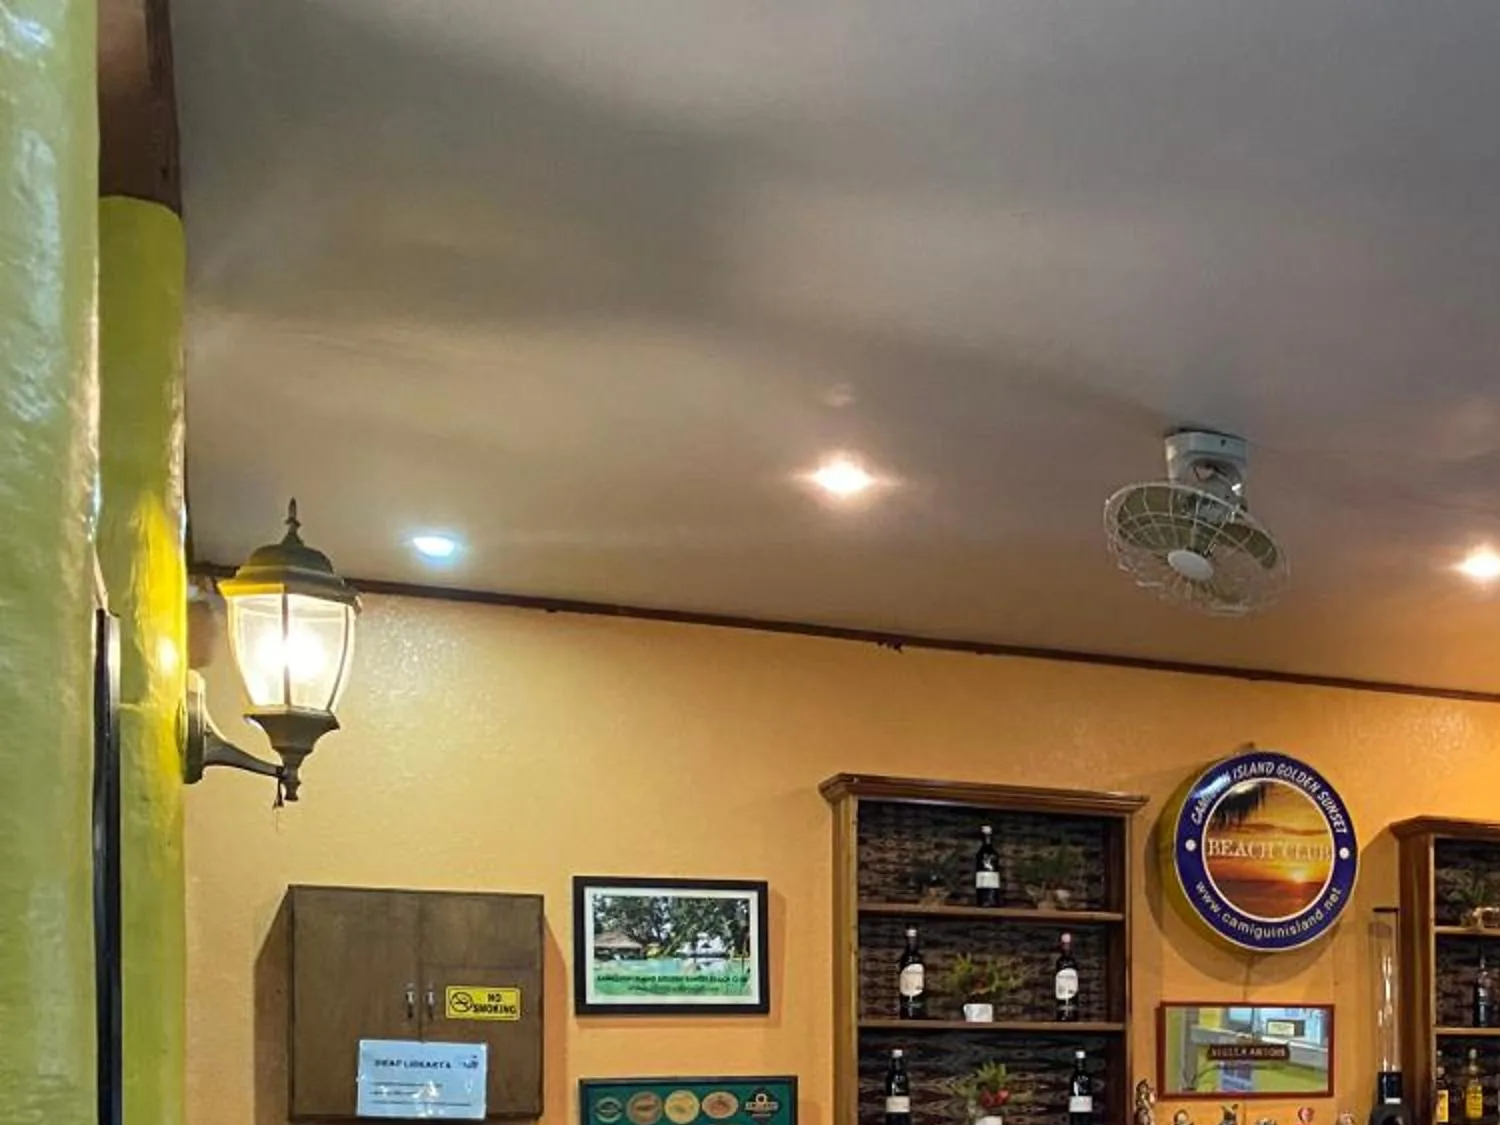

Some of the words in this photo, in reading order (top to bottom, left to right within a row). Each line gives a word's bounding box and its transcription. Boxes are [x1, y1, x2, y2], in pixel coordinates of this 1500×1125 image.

[1233, 761, 1275, 780] ISLAND
[1276, 763, 1320, 792] GOLDEN
[1317, 791, 1348, 834] SUNSET
[1208, 839, 1276, 860] BEACH
[1282, 843, 1330, 861] CLUB
